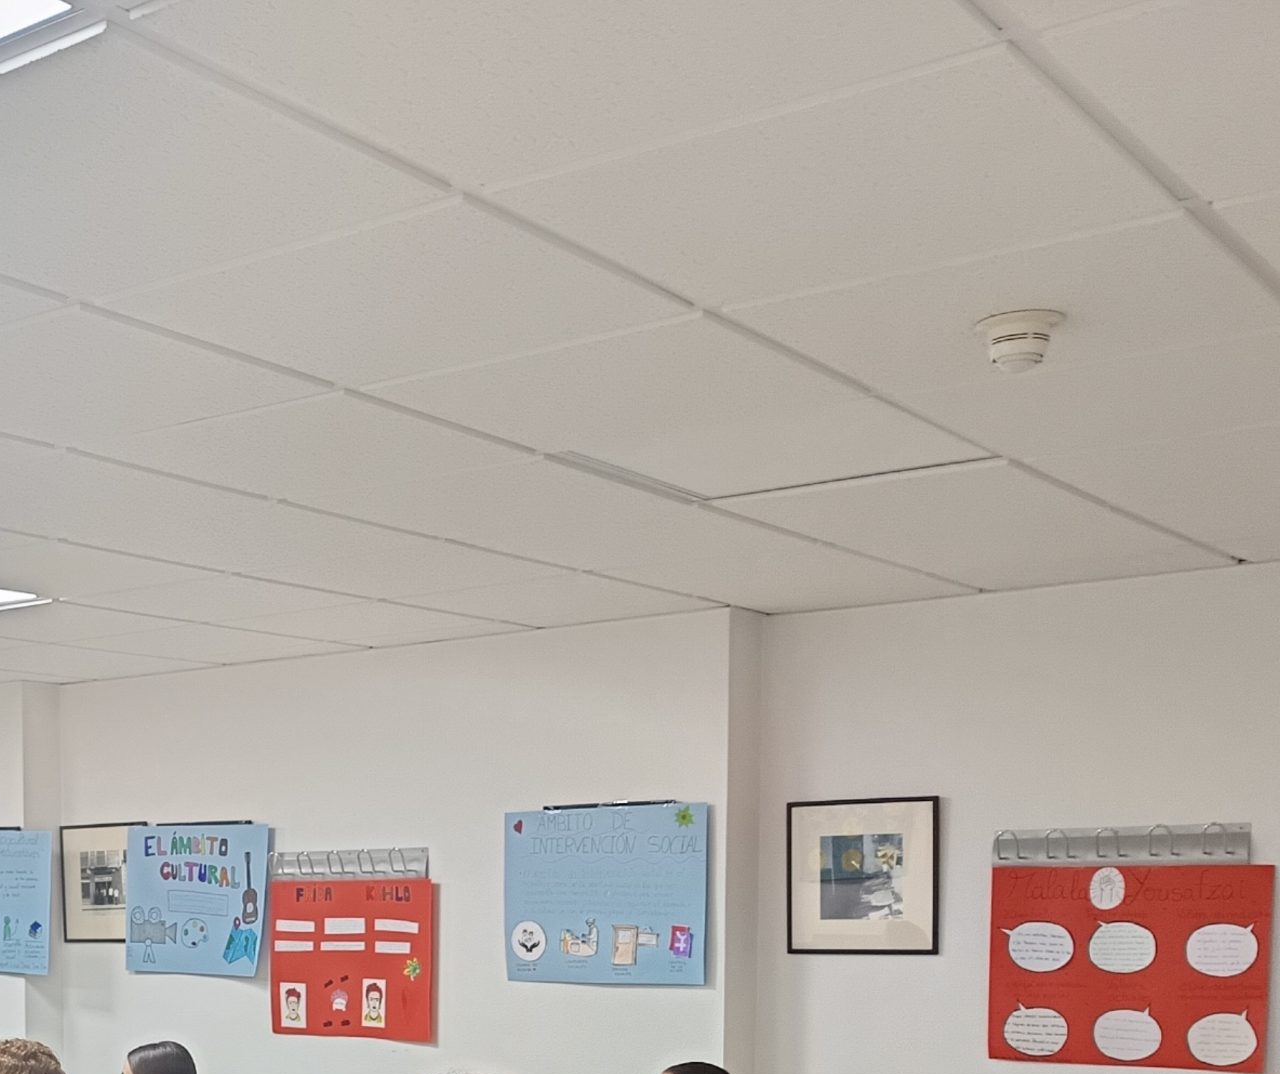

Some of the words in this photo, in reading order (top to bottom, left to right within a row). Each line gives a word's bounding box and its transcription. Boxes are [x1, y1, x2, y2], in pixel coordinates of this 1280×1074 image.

[611, 812, 634, 831] DE
[144, 835, 168, 857] EL
[170, 831, 228, 857] ÁMBITO
[529, 831, 637, 855] INTERVENCIÓN
[647, 834, 704, 855] SOCIAL
[160, 861, 241, 889] CULTURAL
